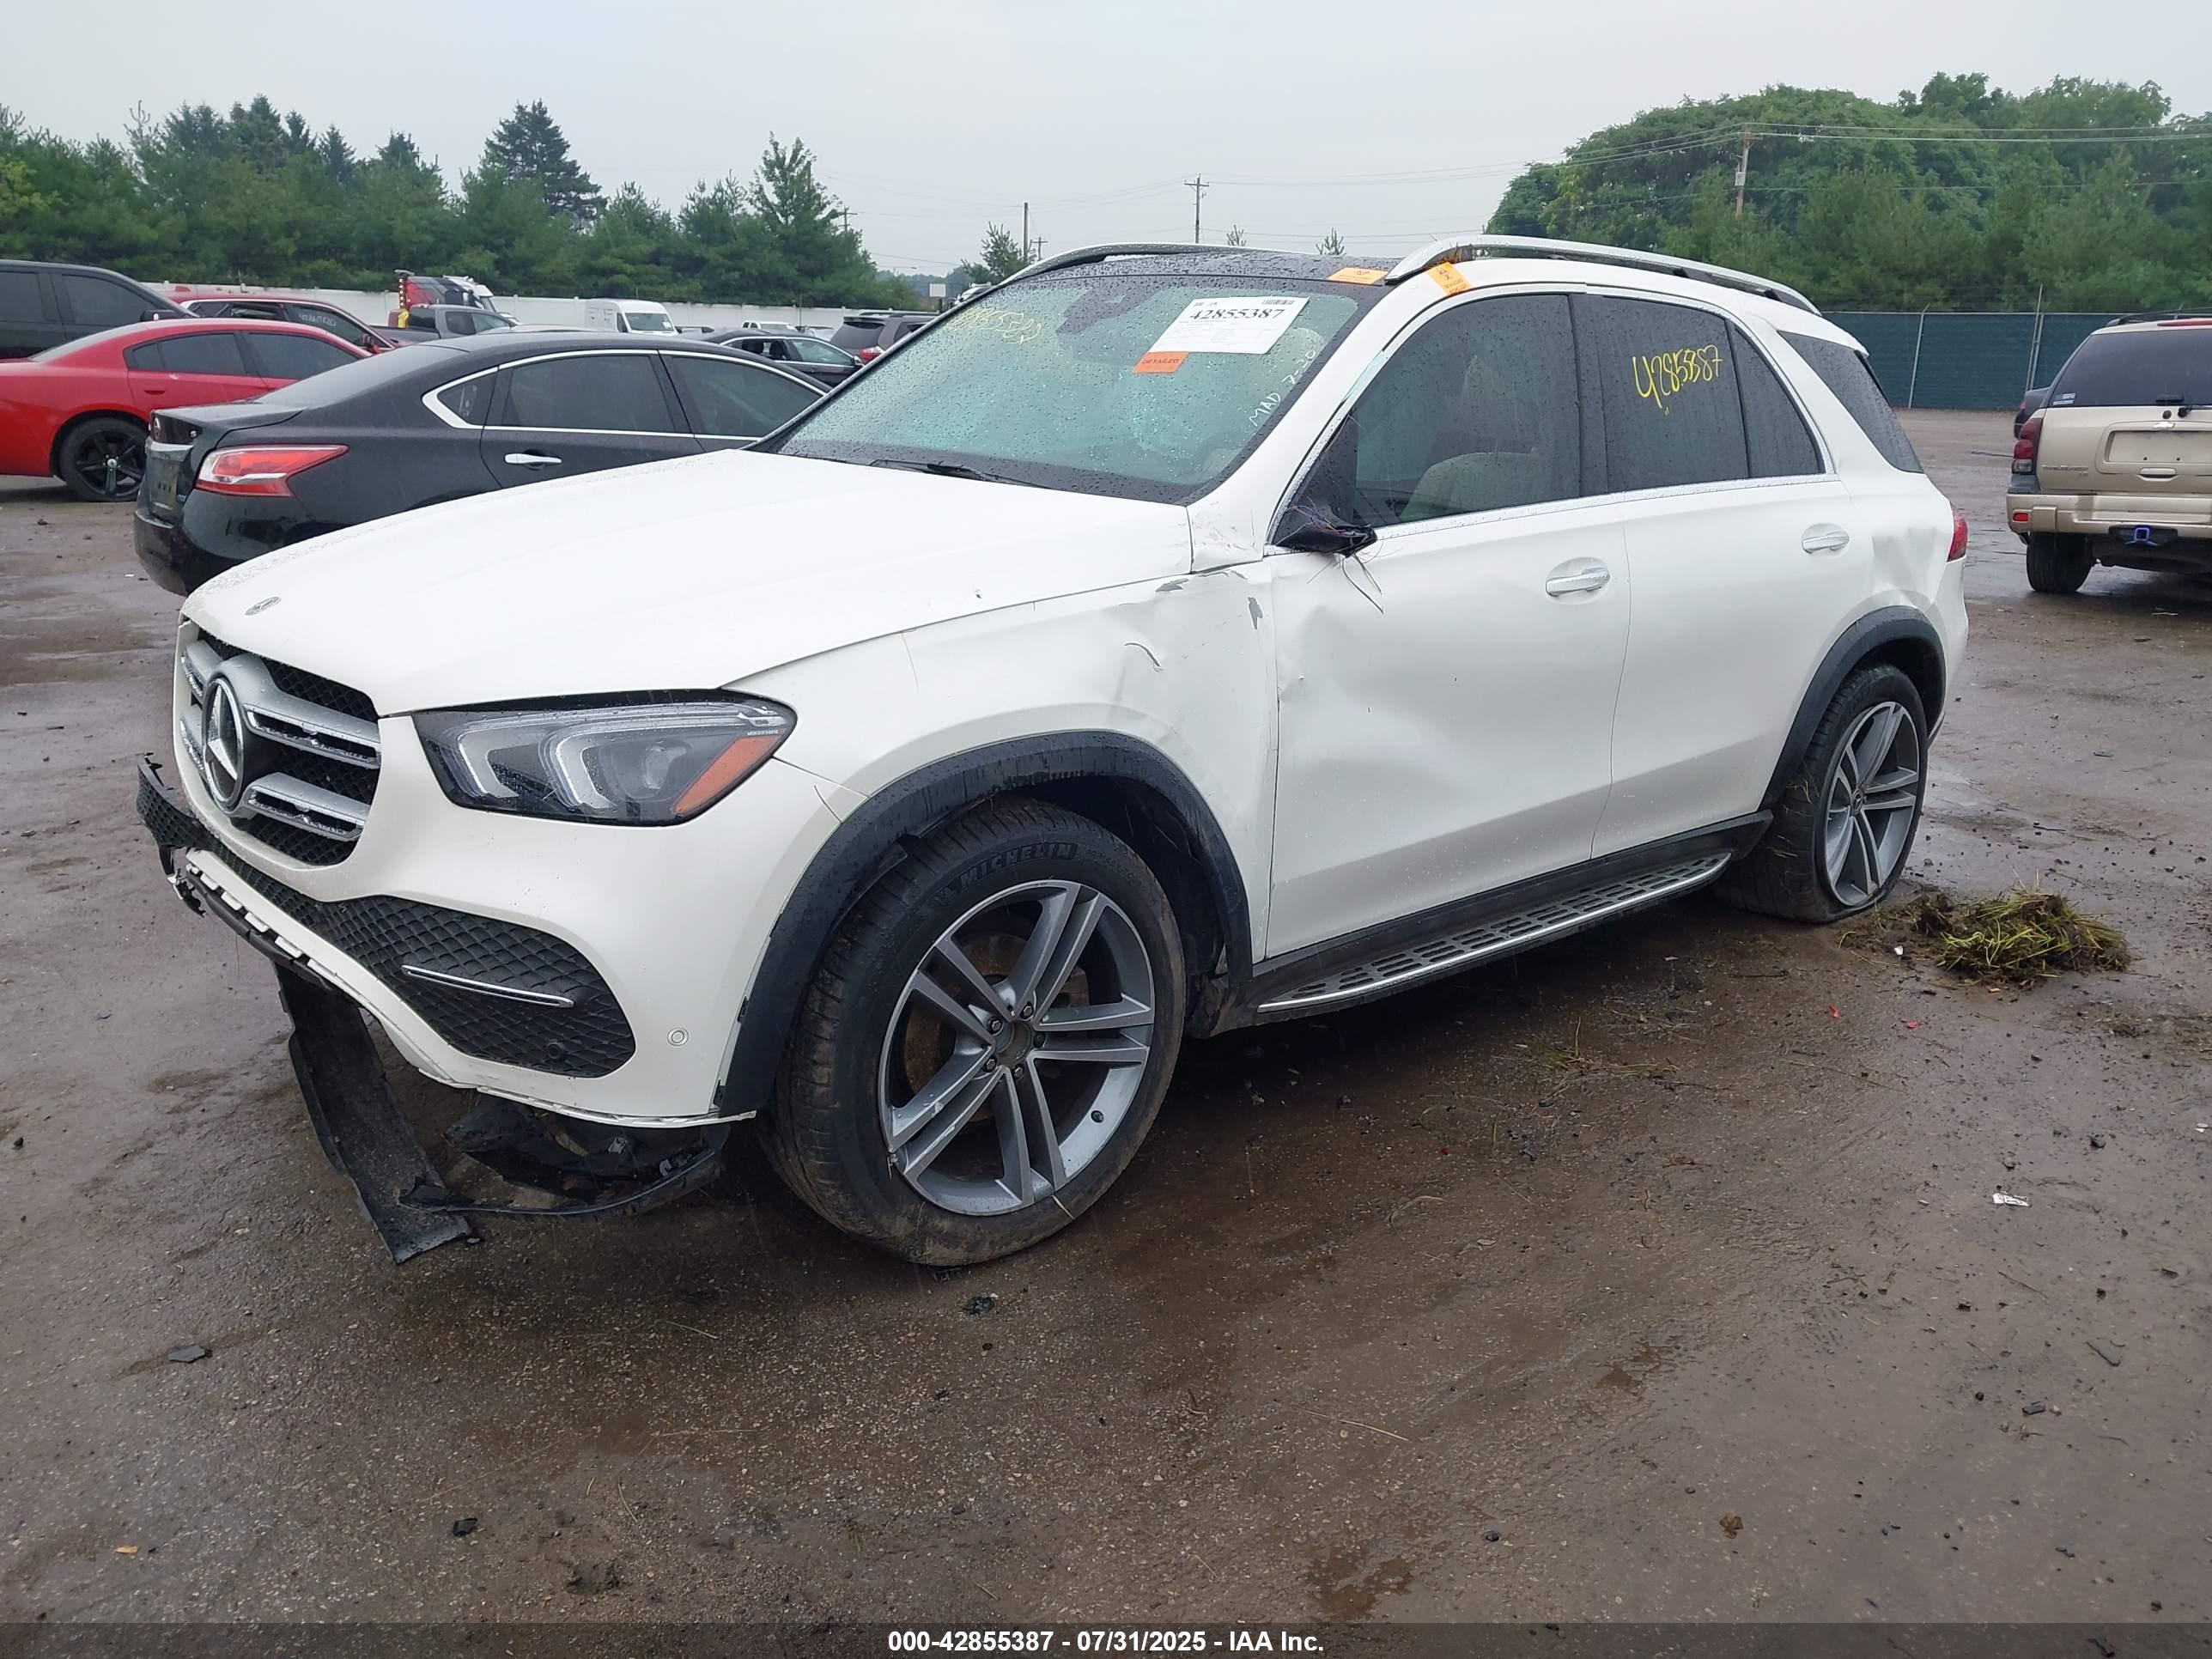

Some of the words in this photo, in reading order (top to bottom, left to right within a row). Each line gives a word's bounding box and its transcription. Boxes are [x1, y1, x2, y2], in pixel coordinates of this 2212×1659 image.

[1189, 308, 1286, 320] 42855387
[1249, 392, 1281, 427] MAD
[959, 842, 1078, 890] MICHELIN
